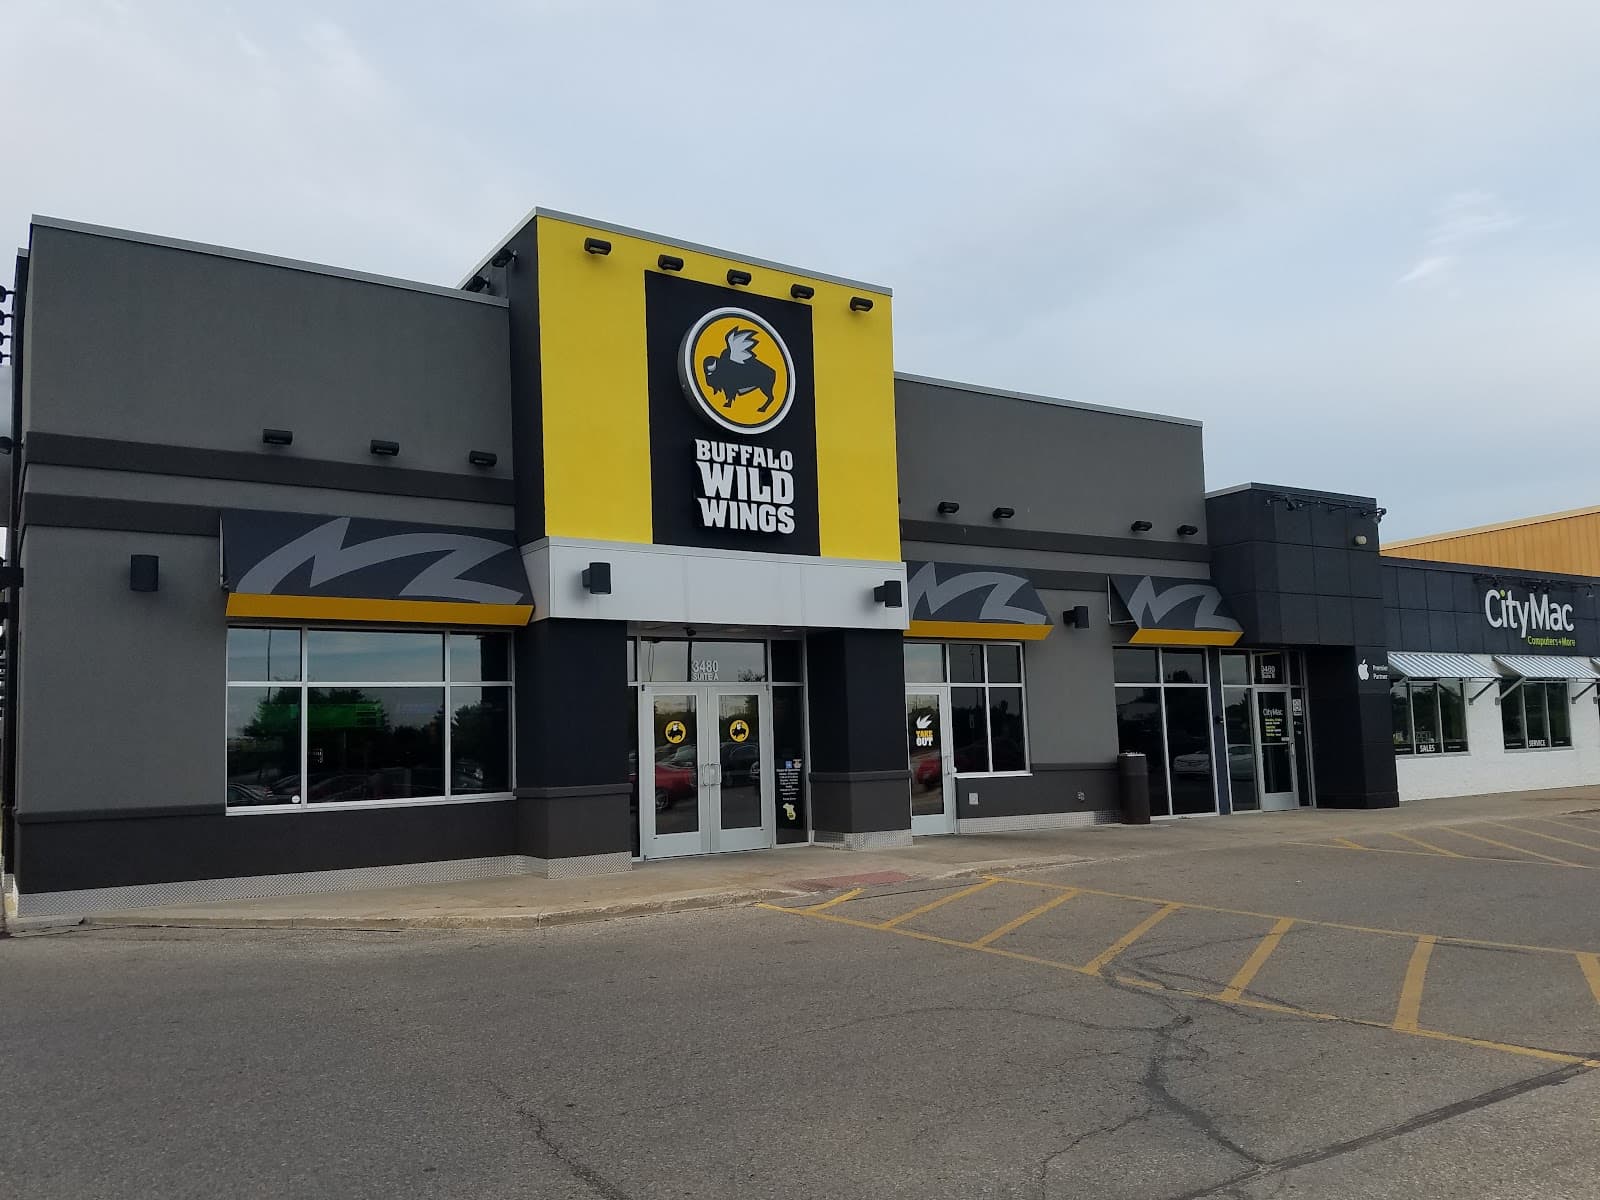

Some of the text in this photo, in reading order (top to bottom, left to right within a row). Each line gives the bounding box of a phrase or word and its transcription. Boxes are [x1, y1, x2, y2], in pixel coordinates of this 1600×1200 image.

[695, 439, 793, 471] BUFFALO
[696, 460, 794, 505] WILD
[697, 498, 795, 534] WINGS
[1485, 589, 1575, 638] CityMac
[692, 660, 719, 673] 3480
[915, 730, 933, 738] TAKE
[916, 736, 934, 747] OUT
[1420, 744, 1436, 753] SALES
